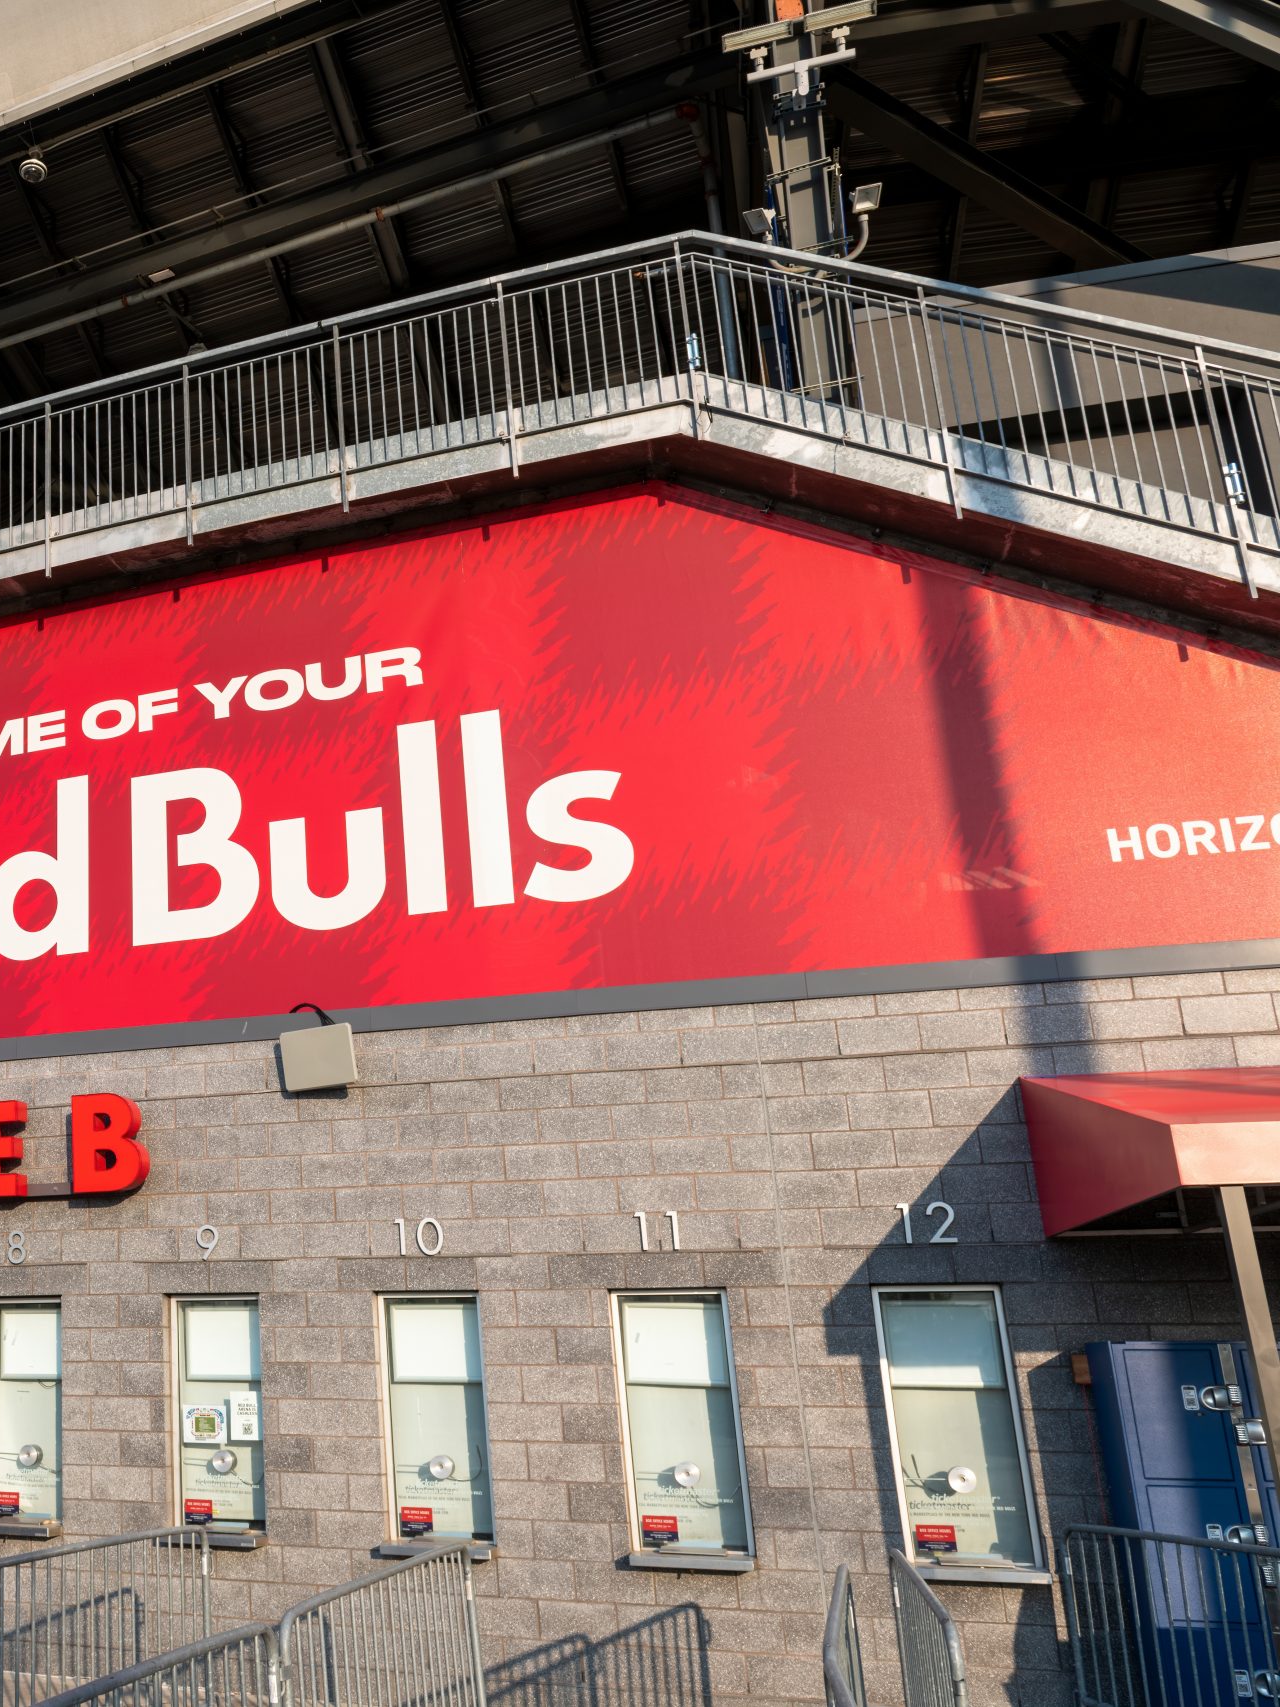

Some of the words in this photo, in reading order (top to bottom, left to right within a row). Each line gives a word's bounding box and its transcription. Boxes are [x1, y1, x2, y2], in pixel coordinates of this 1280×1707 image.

[81, 688, 179, 740] OF
[193, 647, 424, 720] YOUR
[130, 710, 635, 947] Bulls
[71, 1093, 151, 1194] B
[195, 1224, 219, 1261] 9
[393, 1217, 444, 1256] 10
[633, 1210, 680, 1251] 11
[895, 1201, 959, 1245] 12
[7, 1231, 27, 1265] 8
